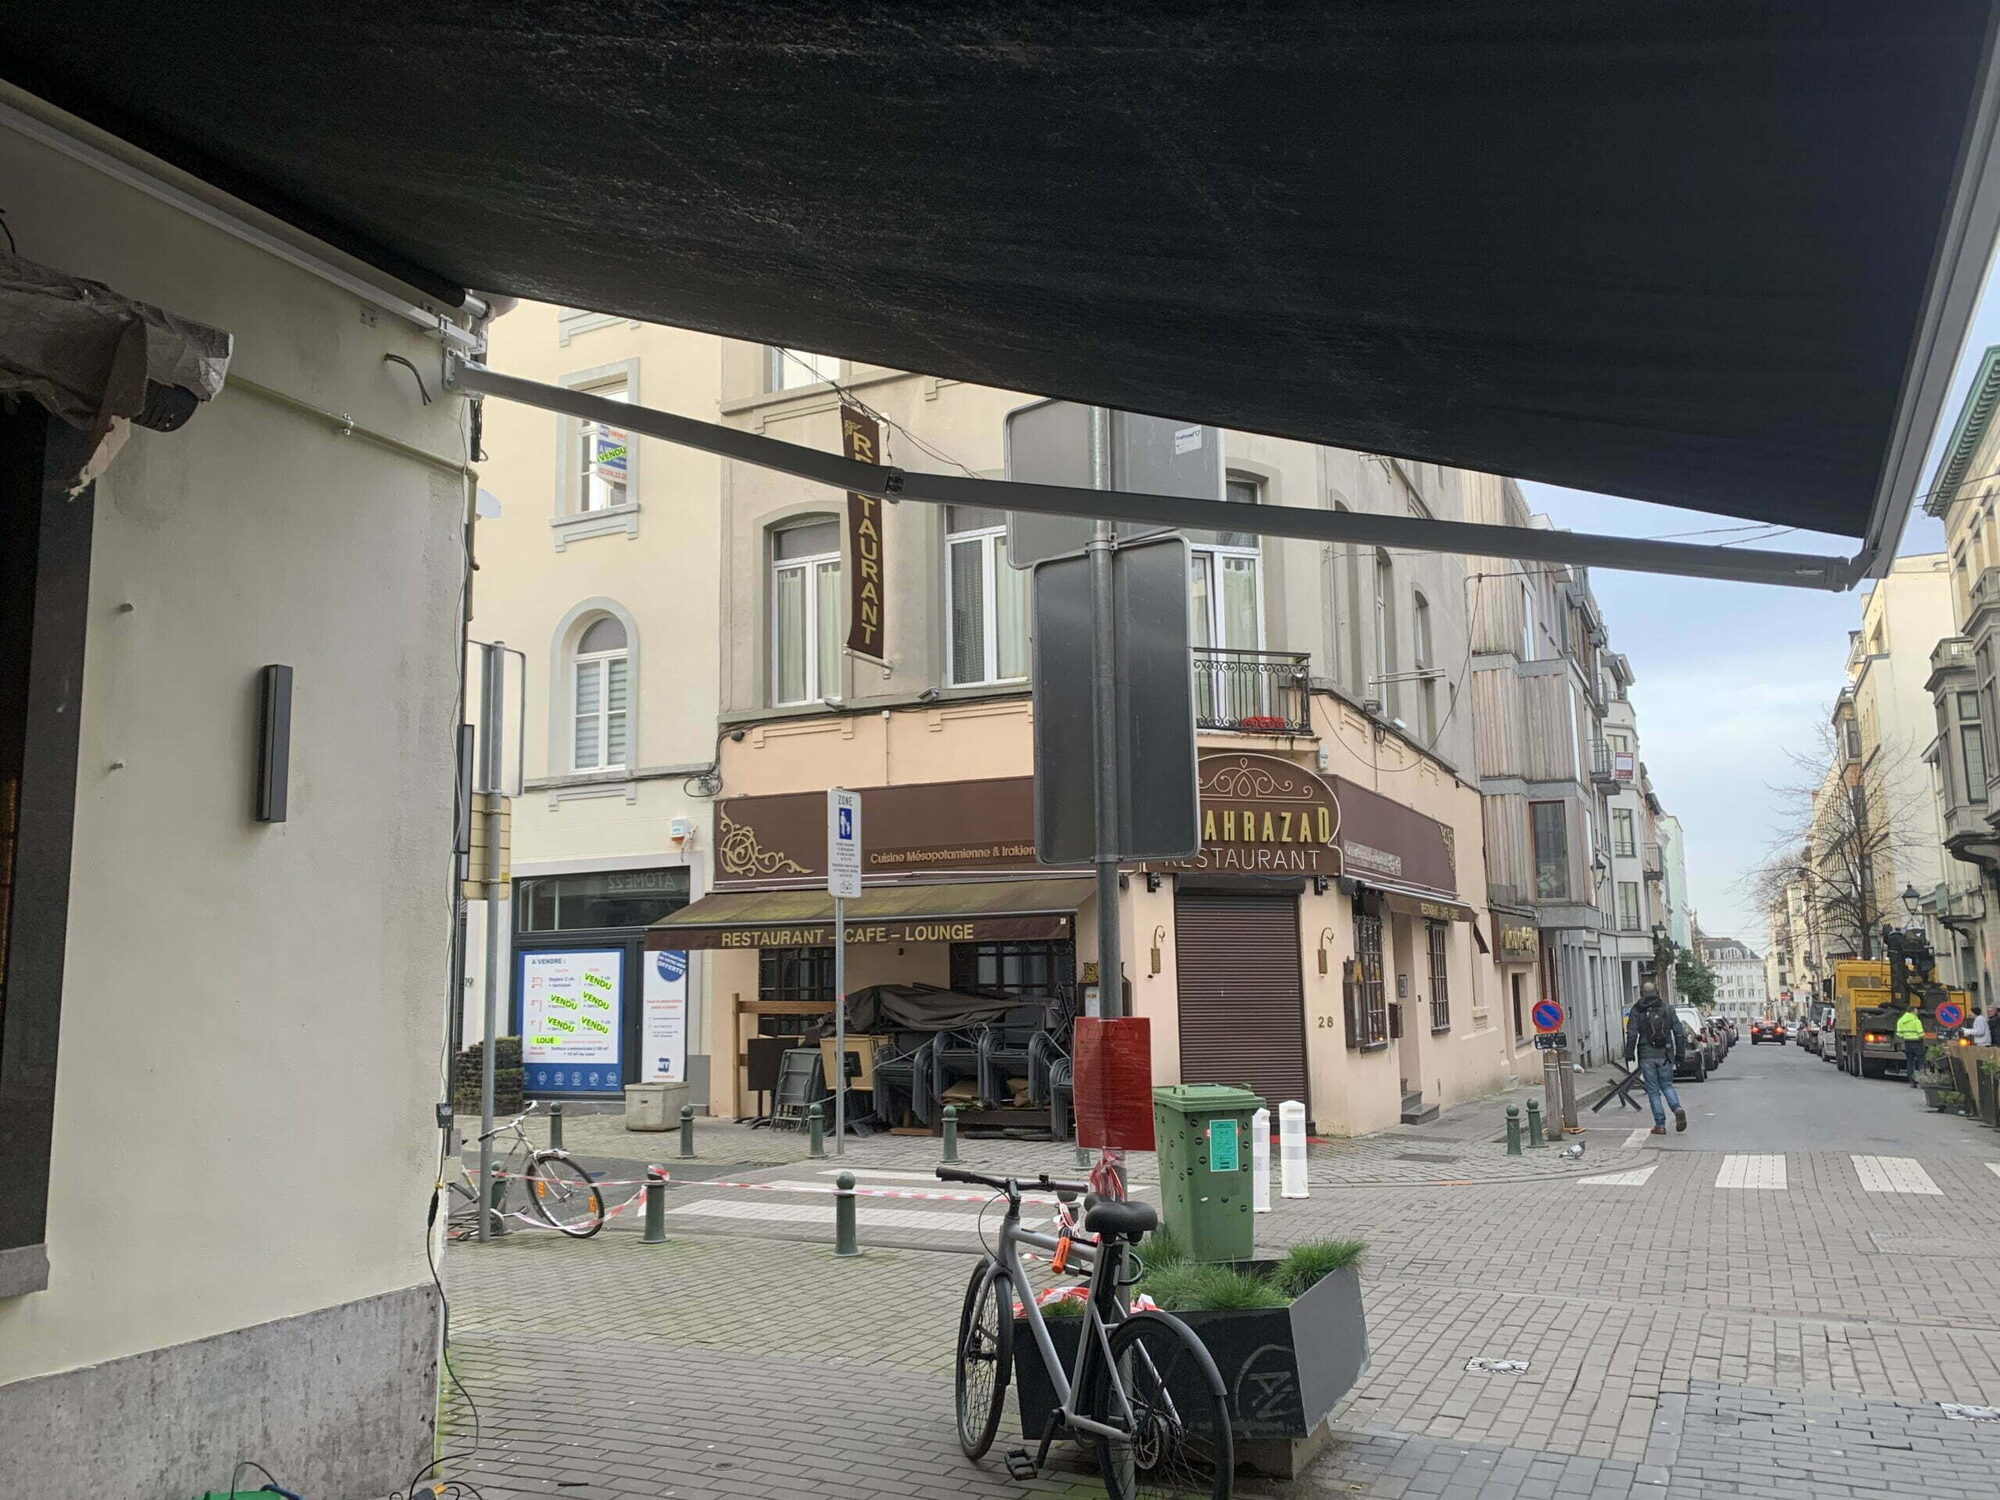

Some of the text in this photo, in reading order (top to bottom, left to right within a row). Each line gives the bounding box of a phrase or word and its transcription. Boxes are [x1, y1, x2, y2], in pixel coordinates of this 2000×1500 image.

[599, 446, 627, 461] VENDU
[852, 432, 880, 645] RTAURANT
[838, 794, 853, 807] ZONE
[1202, 806, 1330, 844] AHRAZAD
[870, 845, 1036, 864] Cuisine Mésopotamienne & Irakien
[1164, 847, 1321, 871] STAURANT
[721, 928, 825, 947] RESTAURANT
[843, 927, 887, 943] CAFE
[904, 923, 975, 942] LOUNGE
[658, 960, 684, 975] OFFERTE
[584, 972, 612, 990] VENDU
[550, 994, 578, 1010] VENDU
[582, 991, 609, 1010] VENDU
[547, 1016, 575, 1032] VENDU
[581, 1016, 609, 1034] VENDU
[1318, 1015, 1334, 1028] 28
